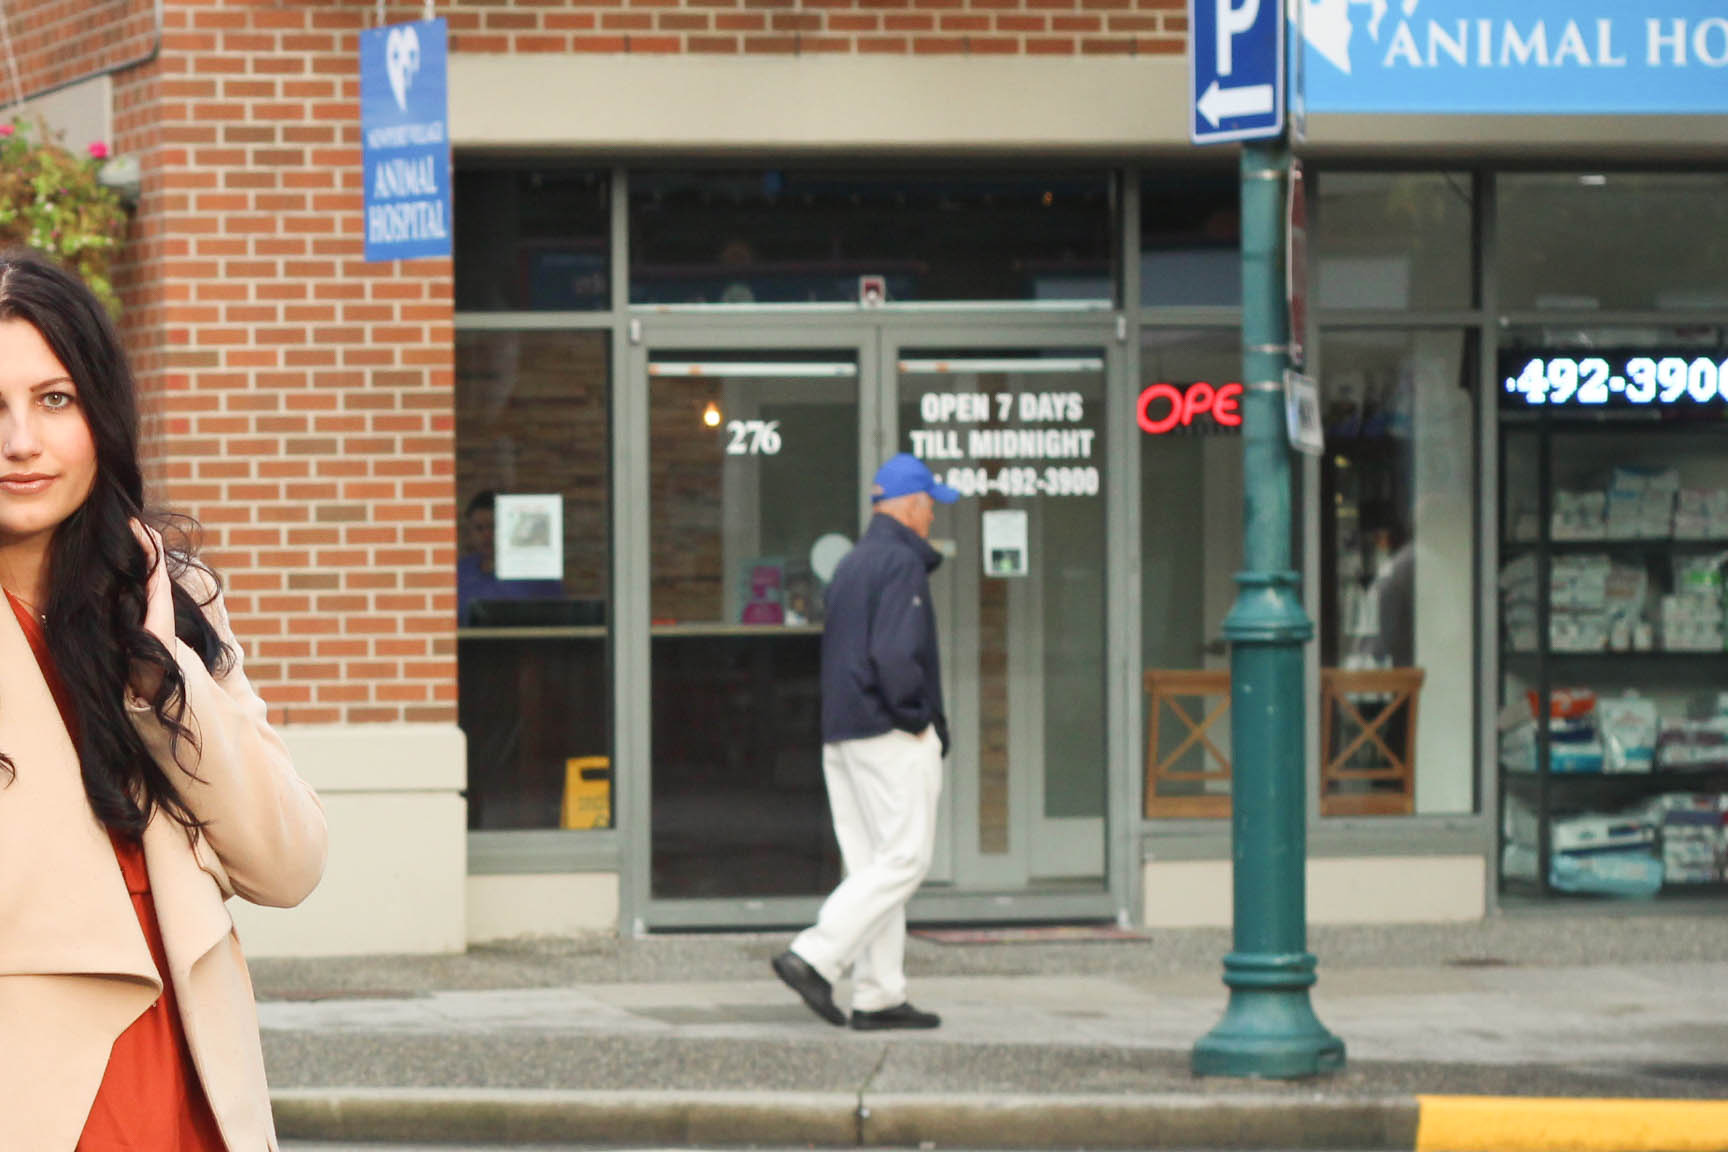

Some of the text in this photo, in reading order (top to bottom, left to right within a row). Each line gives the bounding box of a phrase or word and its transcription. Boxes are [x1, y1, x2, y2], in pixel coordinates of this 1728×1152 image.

[1382, 18, 1628, 68] ANIMAL
[374, 155, 438, 199] ANIMAL
[369, 199, 447, 243] HOSPITAL
[921, 391, 1084, 422] OPEN 7 DAYS
[726, 420, 782, 455] 276
[909, 428, 1095, 459] TILL MIDNIGHT
